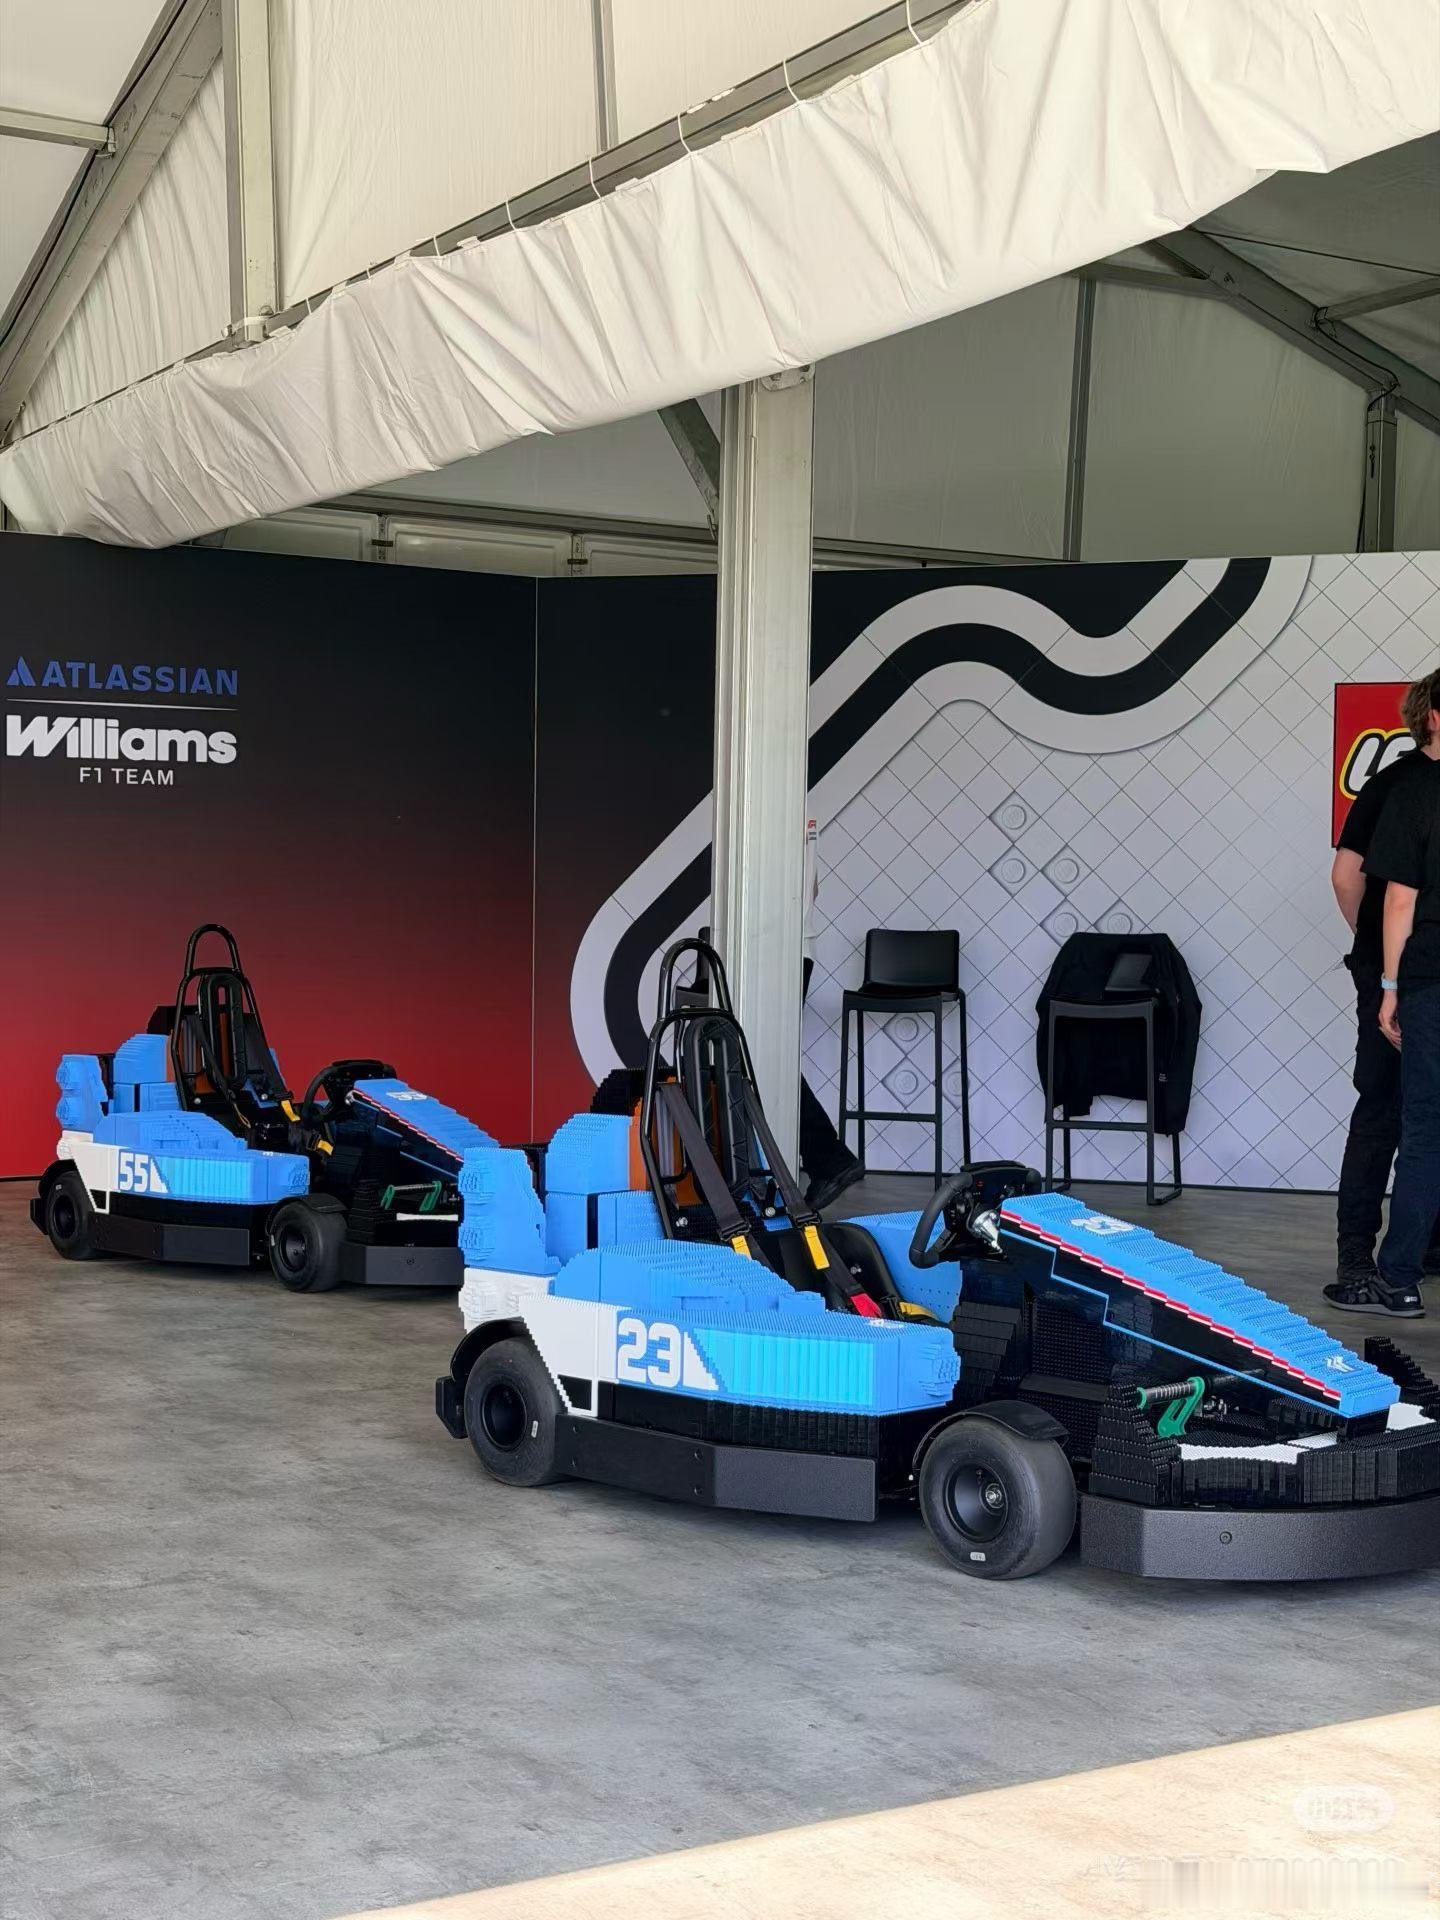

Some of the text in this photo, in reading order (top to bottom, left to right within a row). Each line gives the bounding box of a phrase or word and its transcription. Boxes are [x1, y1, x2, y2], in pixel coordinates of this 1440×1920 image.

[41, 661, 239, 696] ATLASSIAN
[6, 714, 238, 764] Williams
[79, 767, 174, 786] F1 TEAM
[119, 1151, 149, 1193] 55
[617, 1317, 682, 1388] 23
